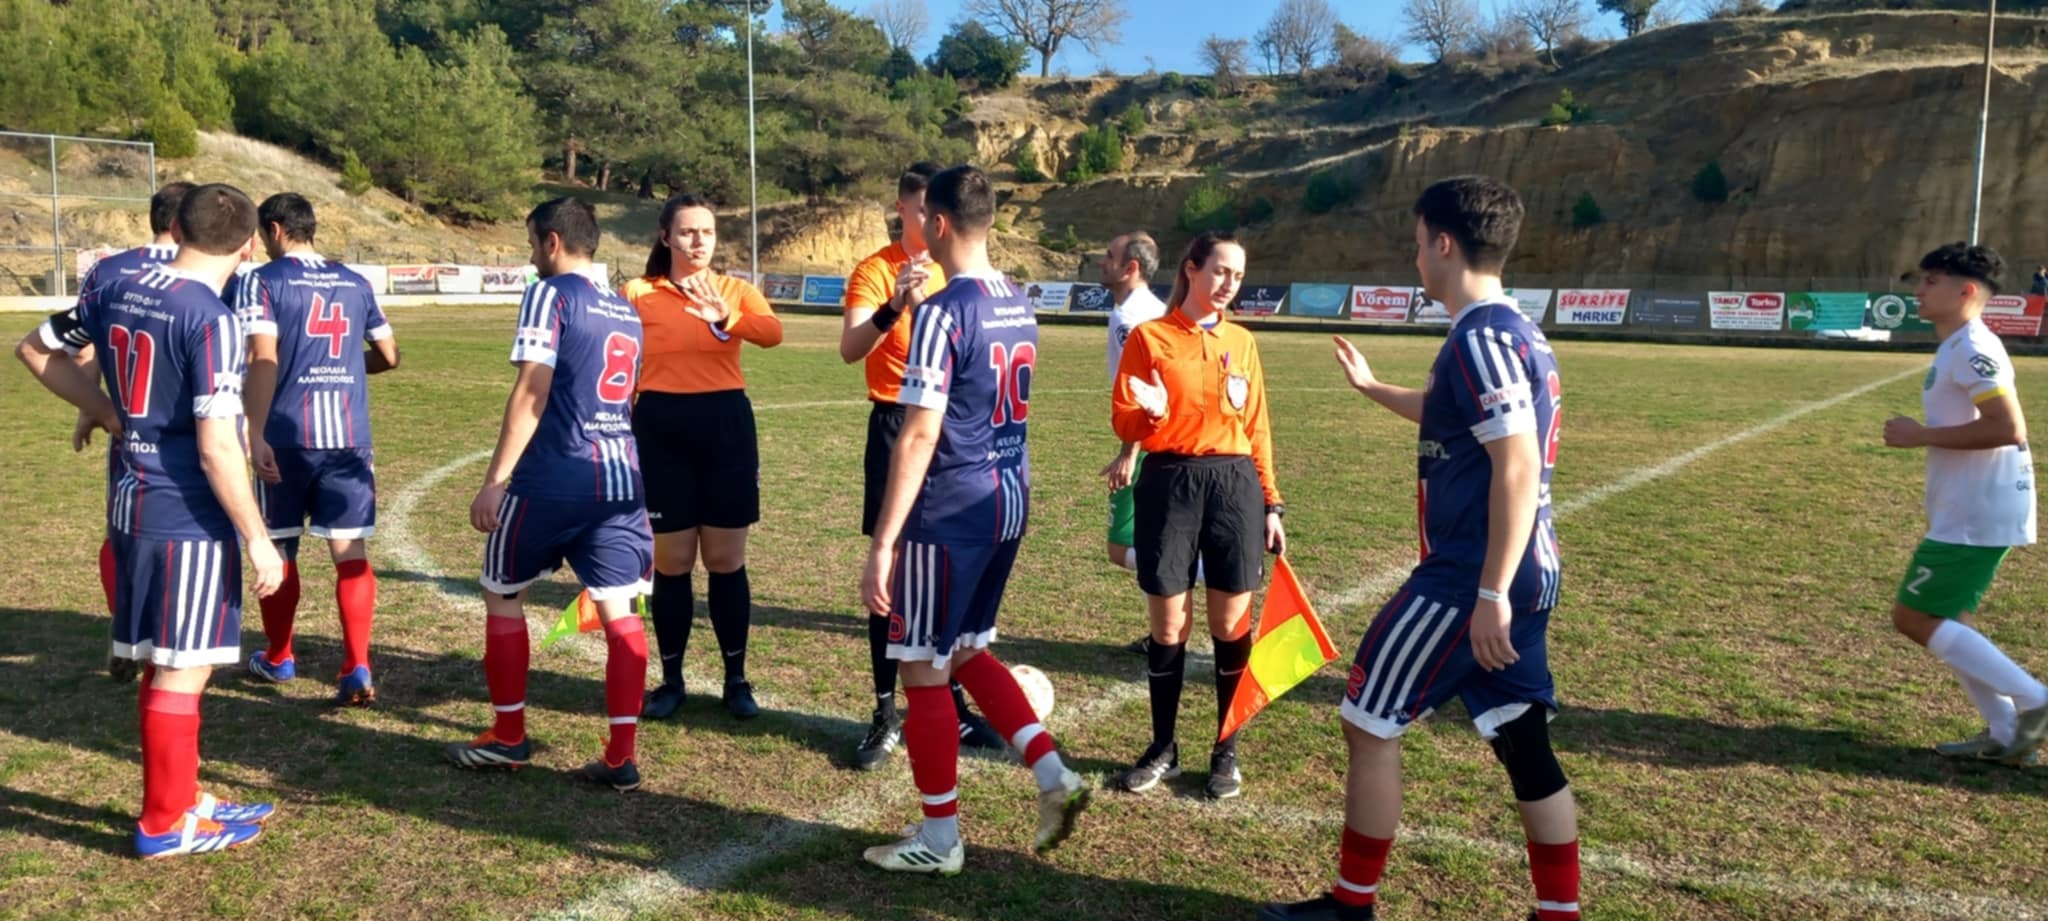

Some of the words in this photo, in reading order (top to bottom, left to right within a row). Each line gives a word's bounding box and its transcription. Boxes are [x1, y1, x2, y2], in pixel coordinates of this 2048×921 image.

[305, 291, 350, 359] 4
[109, 323, 155, 418] 11
[597, 331, 640, 404] 8
[990, 341, 1036, 428] 10
[1907, 566, 1933, 596] 2
